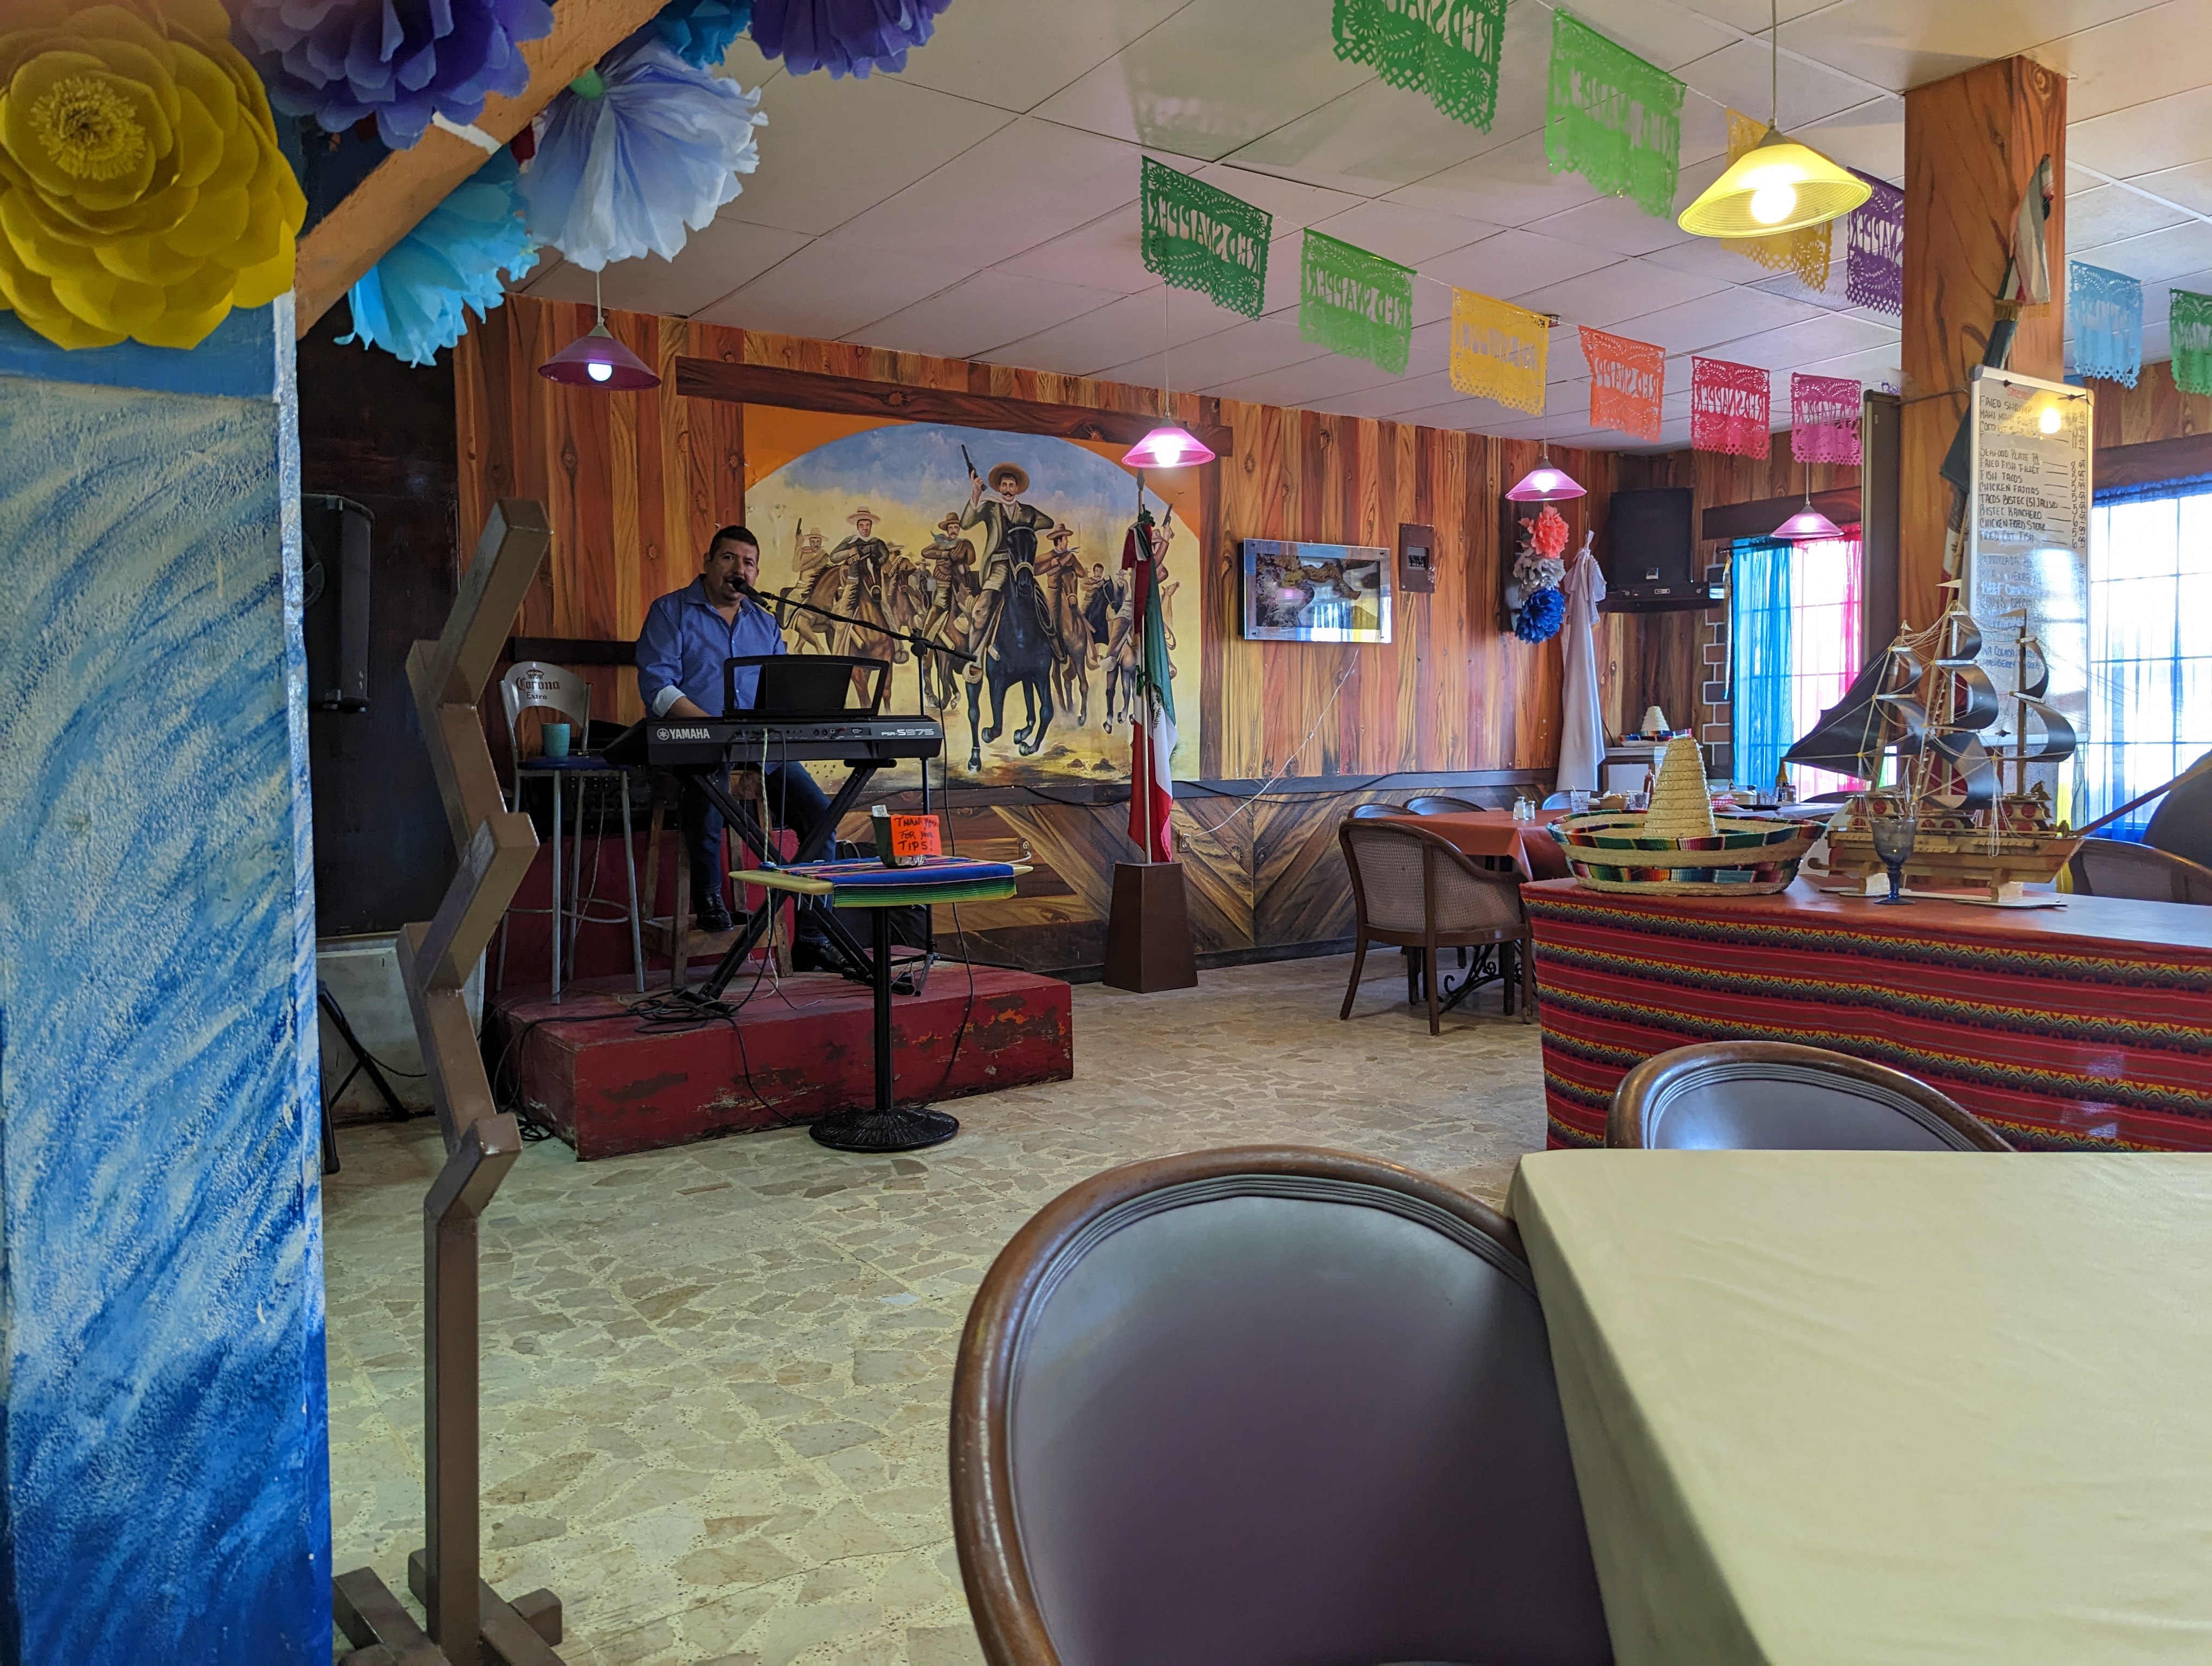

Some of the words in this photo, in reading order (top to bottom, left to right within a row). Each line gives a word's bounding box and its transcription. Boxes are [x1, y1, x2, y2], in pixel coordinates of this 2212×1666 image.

[1979, 395, 2002, 408] FRIED
[2004, 401, 2032, 414] SHRIMP
[1980, 409, 1996, 419] MAHI
[2011, 449, 2029, 460] PLATE
[1980, 458, 1999, 467] FRIED
[2002, 460, 2016, 470] FISH
[2018, 464, 2040, 474] FILLET
[1979, 470, 1997, 480] FISH
[2001, 472, 2022, 483] TACOS
[1979, 482, 2010, 492] CHICKEN
[1979, 494, 2001, 504] TACOS
[2003, 495, 2024, 505] BISTEC
[1980, 504, 2005, 516] BISTEC
[2008, 507, 2042, 520] RANCHERO
[1979, 518, 2008, 528] CHICKEN
[2027, 520, 2046, 531] STEAK
[1979, 530, 1999, 541] FRIED
[2002, 530, 2015, 542] CAT
[2018, 531, 2034, 542] FISH
[516, 677, 561, 693] Corona
[526, 692, 548, 700] Extra
[669, 728, 710, 740] YAMAHA
[881, 728, 935, 737] PSR-S975
[893, 816, 921, 826] THANK
[898, 829, 916, 840] FOR
[897, 840, 933, 851] TIPS!
